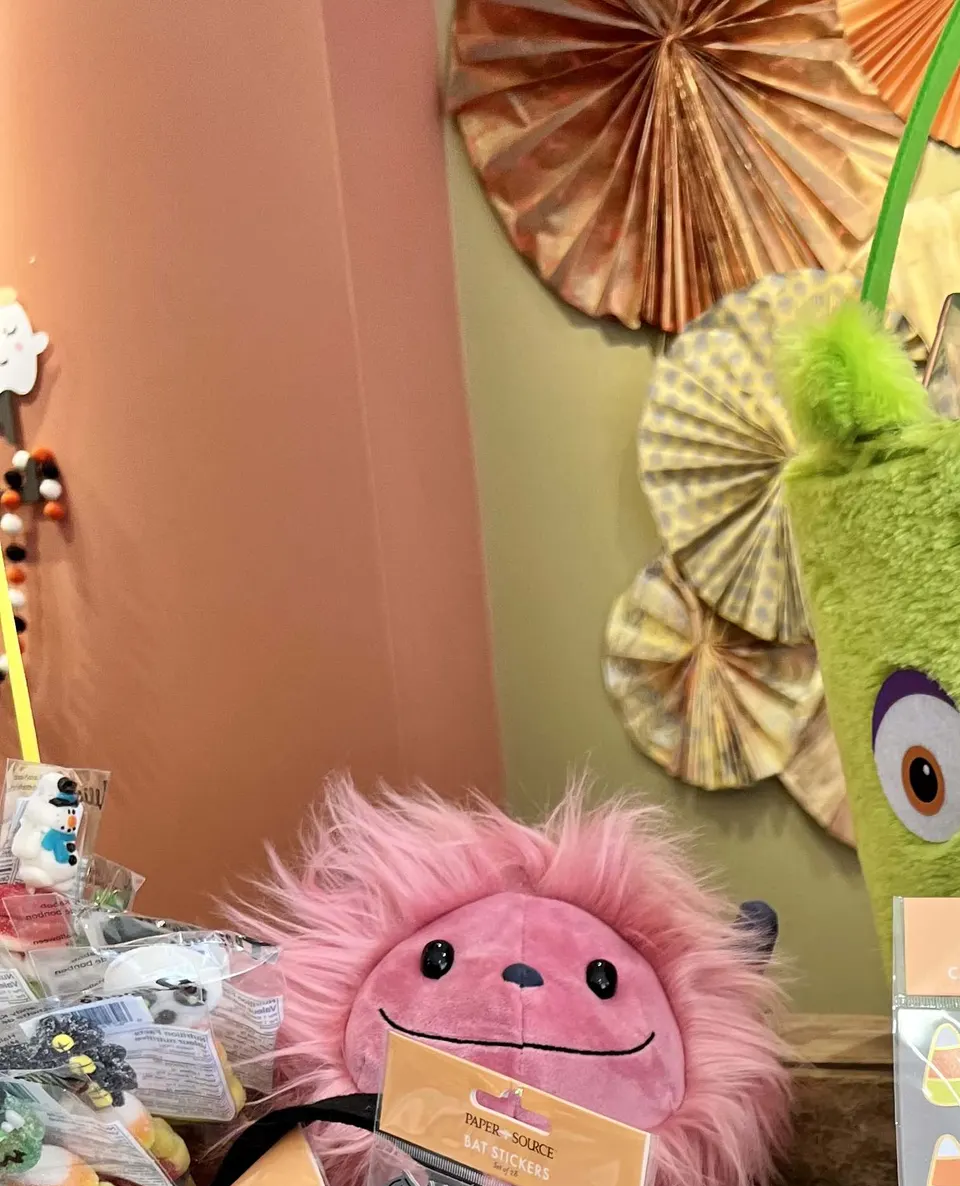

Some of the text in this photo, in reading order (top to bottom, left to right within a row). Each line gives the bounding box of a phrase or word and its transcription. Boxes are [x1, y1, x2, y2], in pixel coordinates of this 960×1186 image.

[464, 1135, 550, 1181] BAT STICKERS
[465, 1112, 554, 1160] PAPER SOURCE
